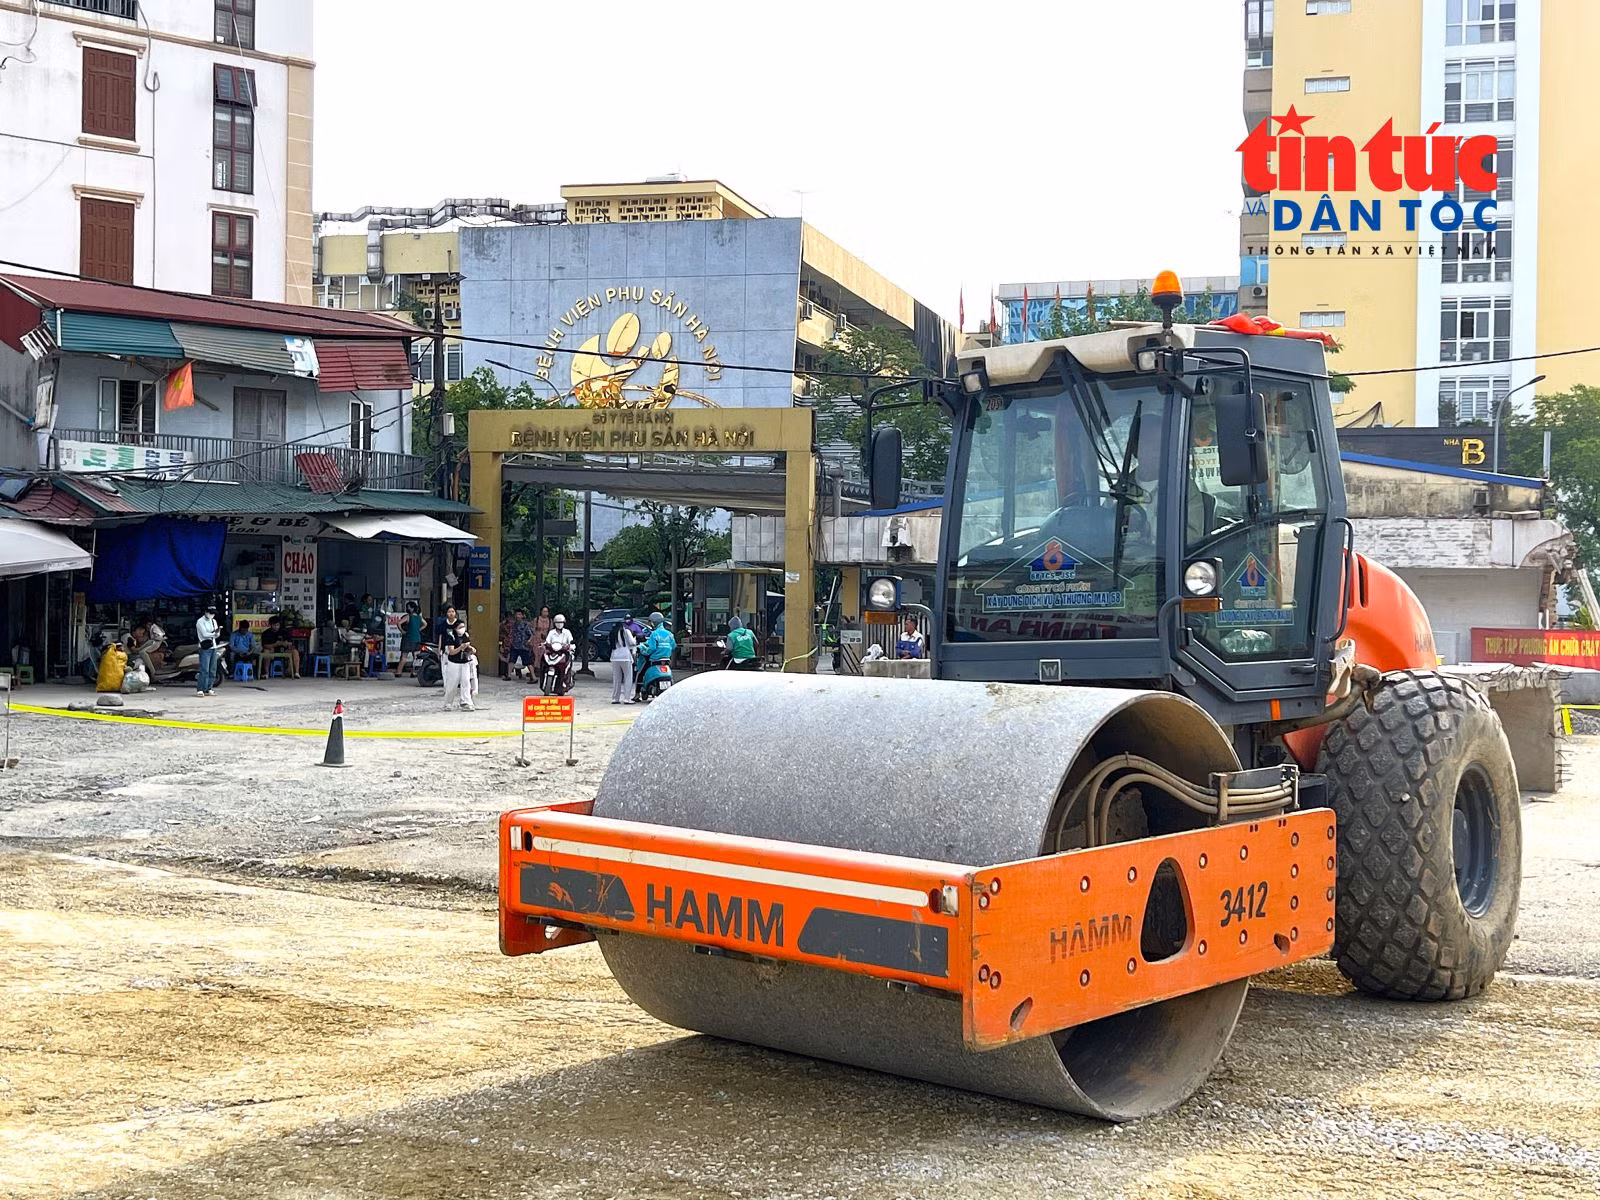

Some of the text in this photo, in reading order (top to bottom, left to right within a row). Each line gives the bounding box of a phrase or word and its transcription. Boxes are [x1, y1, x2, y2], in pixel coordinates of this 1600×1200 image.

[535, 286, 722, 382] BỆNH VIỆN PHỤ SẢN HÀ NỘI
[511, 425, 560, 449] BỆNH
[564, 426, 605, 449] VIỆN
[694, 426, 720, 448] HÀ
[723, 426, 755, 450] NỘI
[1462, 438, 1486, 465] B
[284, 546, 315, 574] CHÁO
[475, 575, 483, 588] 1
[647, 883, 785, 948] HAMM
[1220, 881, 1269, 928] 3412
[1050, 913, 1133, 964] HAMM
